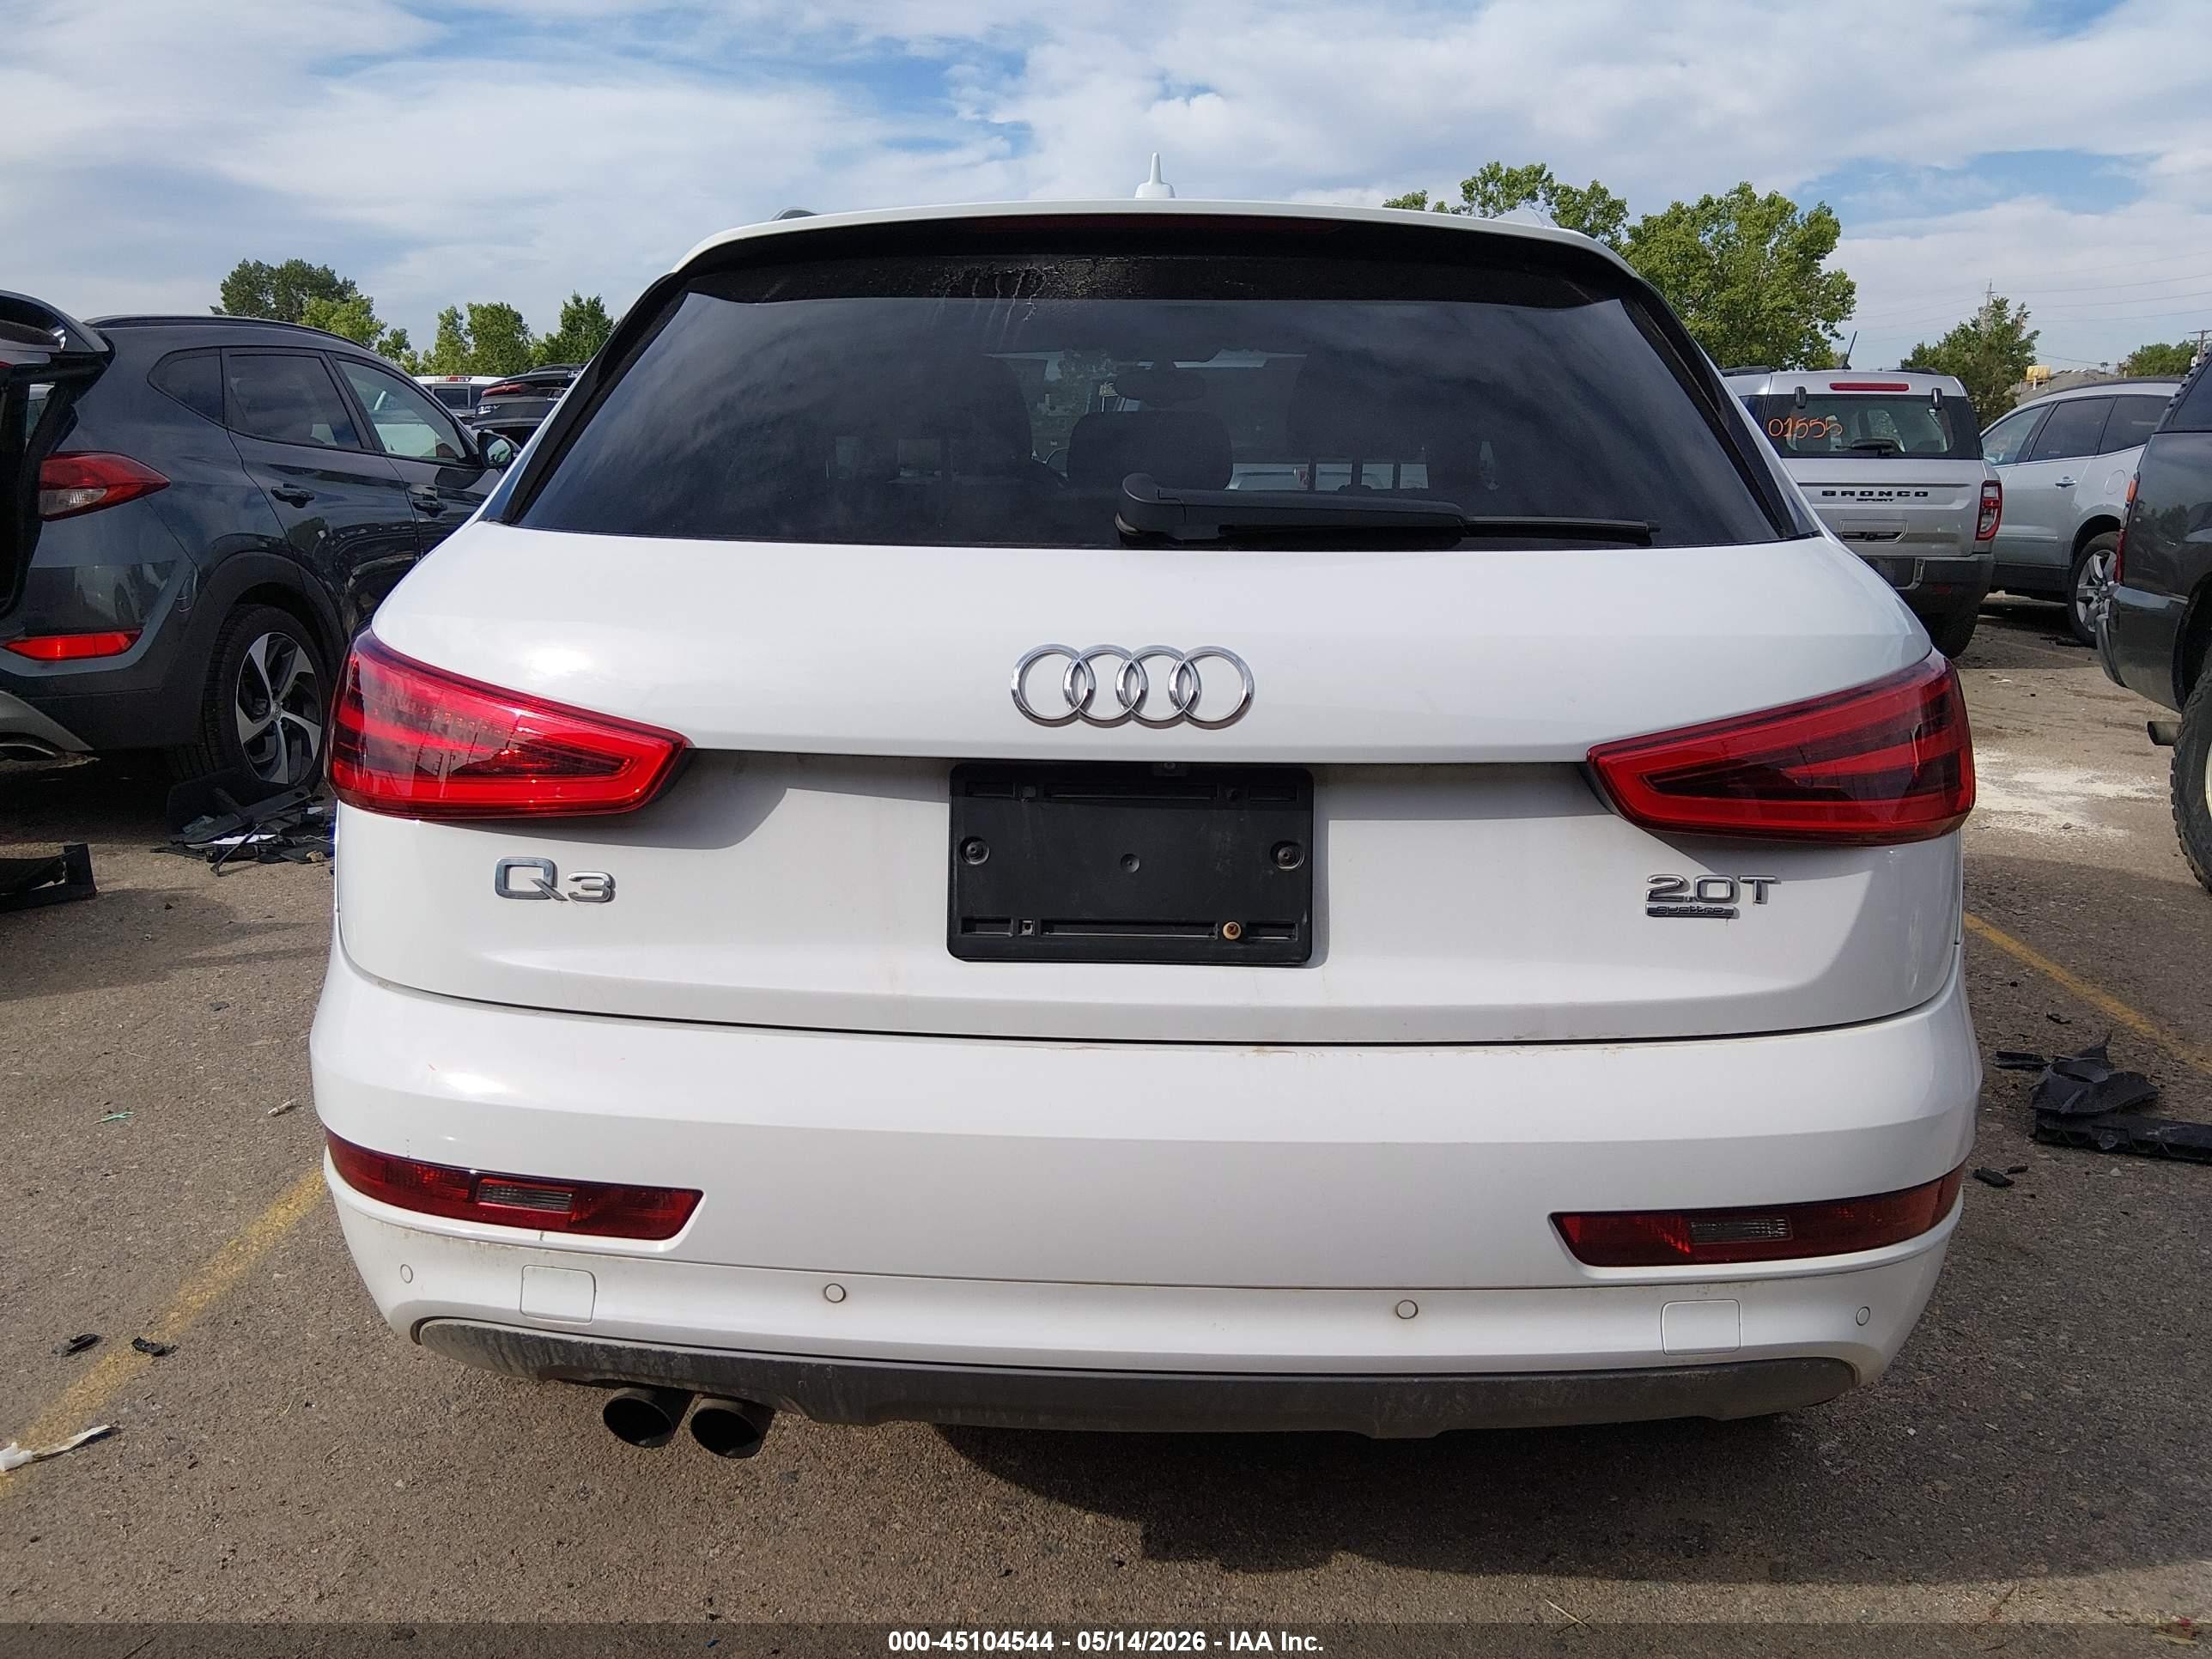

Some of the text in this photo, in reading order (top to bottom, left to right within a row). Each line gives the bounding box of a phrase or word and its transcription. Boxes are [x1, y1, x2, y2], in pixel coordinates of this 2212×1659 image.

[1768, 416, 1843, 439] 01555
[495, 857, 616, 902] Q3
[1646, 873, 1778, 904] 2.0T
[1656, 905, 1725, 915] quattro
